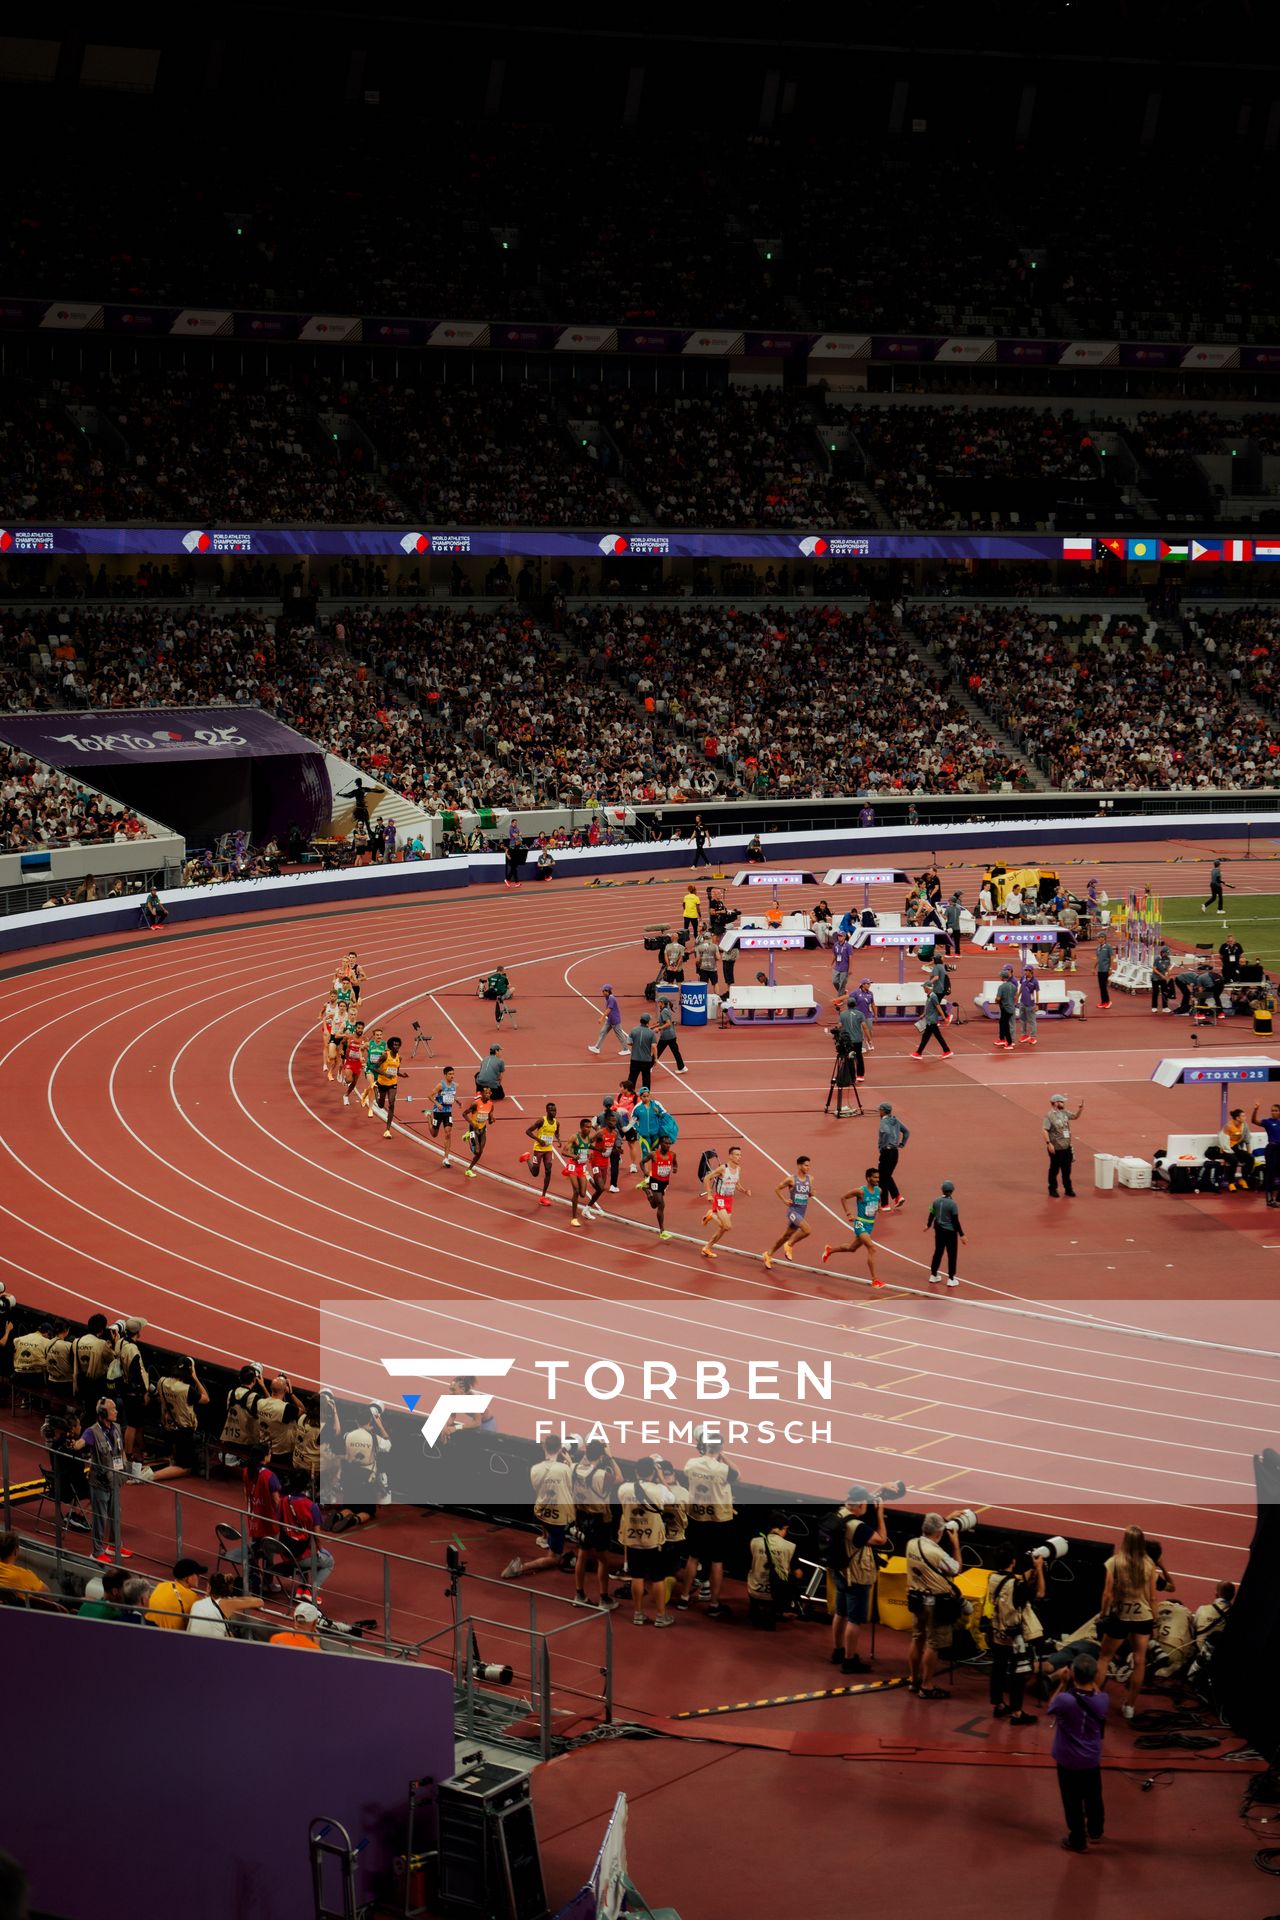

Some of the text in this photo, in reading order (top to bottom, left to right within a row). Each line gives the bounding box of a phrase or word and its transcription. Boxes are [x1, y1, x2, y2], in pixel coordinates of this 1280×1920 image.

[42, 733, 156, 752] TOKYO
[192, 726, 247, 747] 25
[795, 1185, 809, 1193] USA
[627, 1528, 652, 1540] 299
